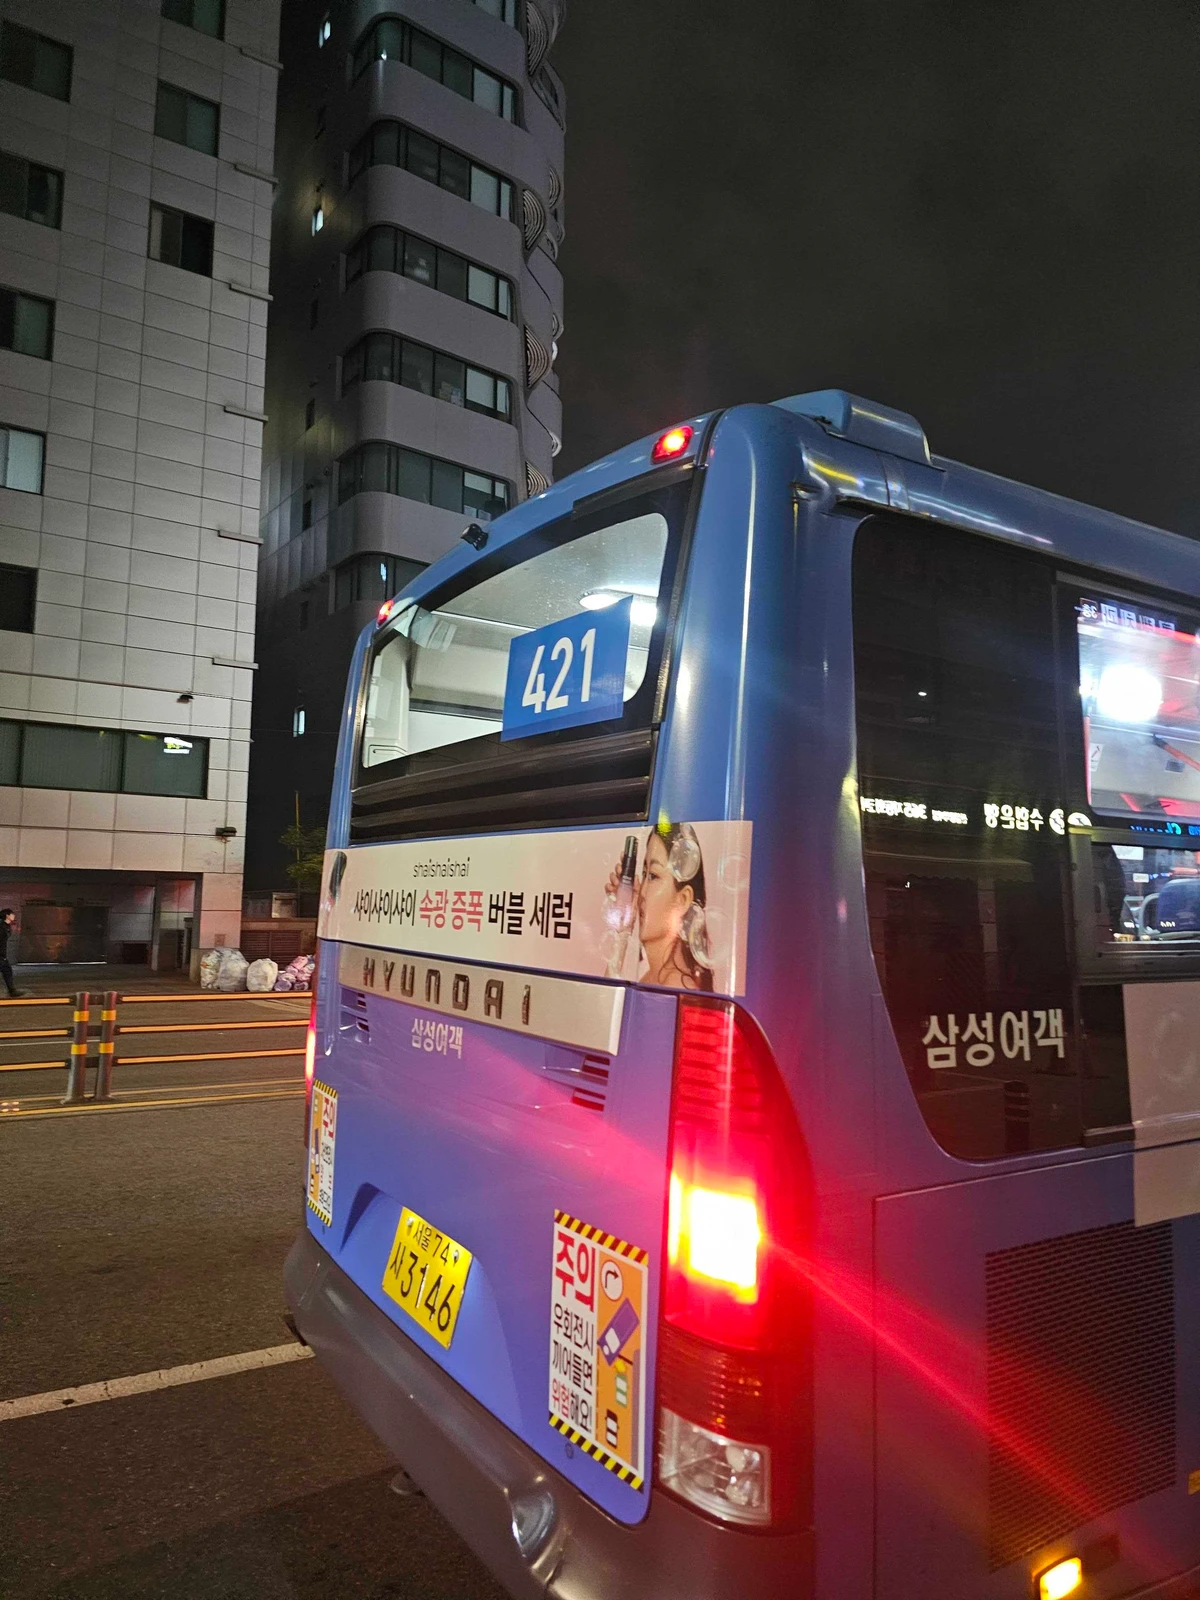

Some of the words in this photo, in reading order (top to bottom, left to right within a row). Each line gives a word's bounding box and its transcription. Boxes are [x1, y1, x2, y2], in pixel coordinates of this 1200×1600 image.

[522, 628, 596, 713] 421
[413, 857, 470, 878] shaishaishai
[353, 889, 417, 926] 샤이샤이샤이
[488, 891, 525, 935] 버블
[529, 892, 573, 940] 세럼
[363, 957, 531, 1026] HYUNDAI
[411, 1018, 464, 1060] 삼성여객
[922, 1008, 1066, 1069] 삼성여객
[555, 1231, 597, 1313] 주의
[552, 1339, 593, 1396] 끼어들면
